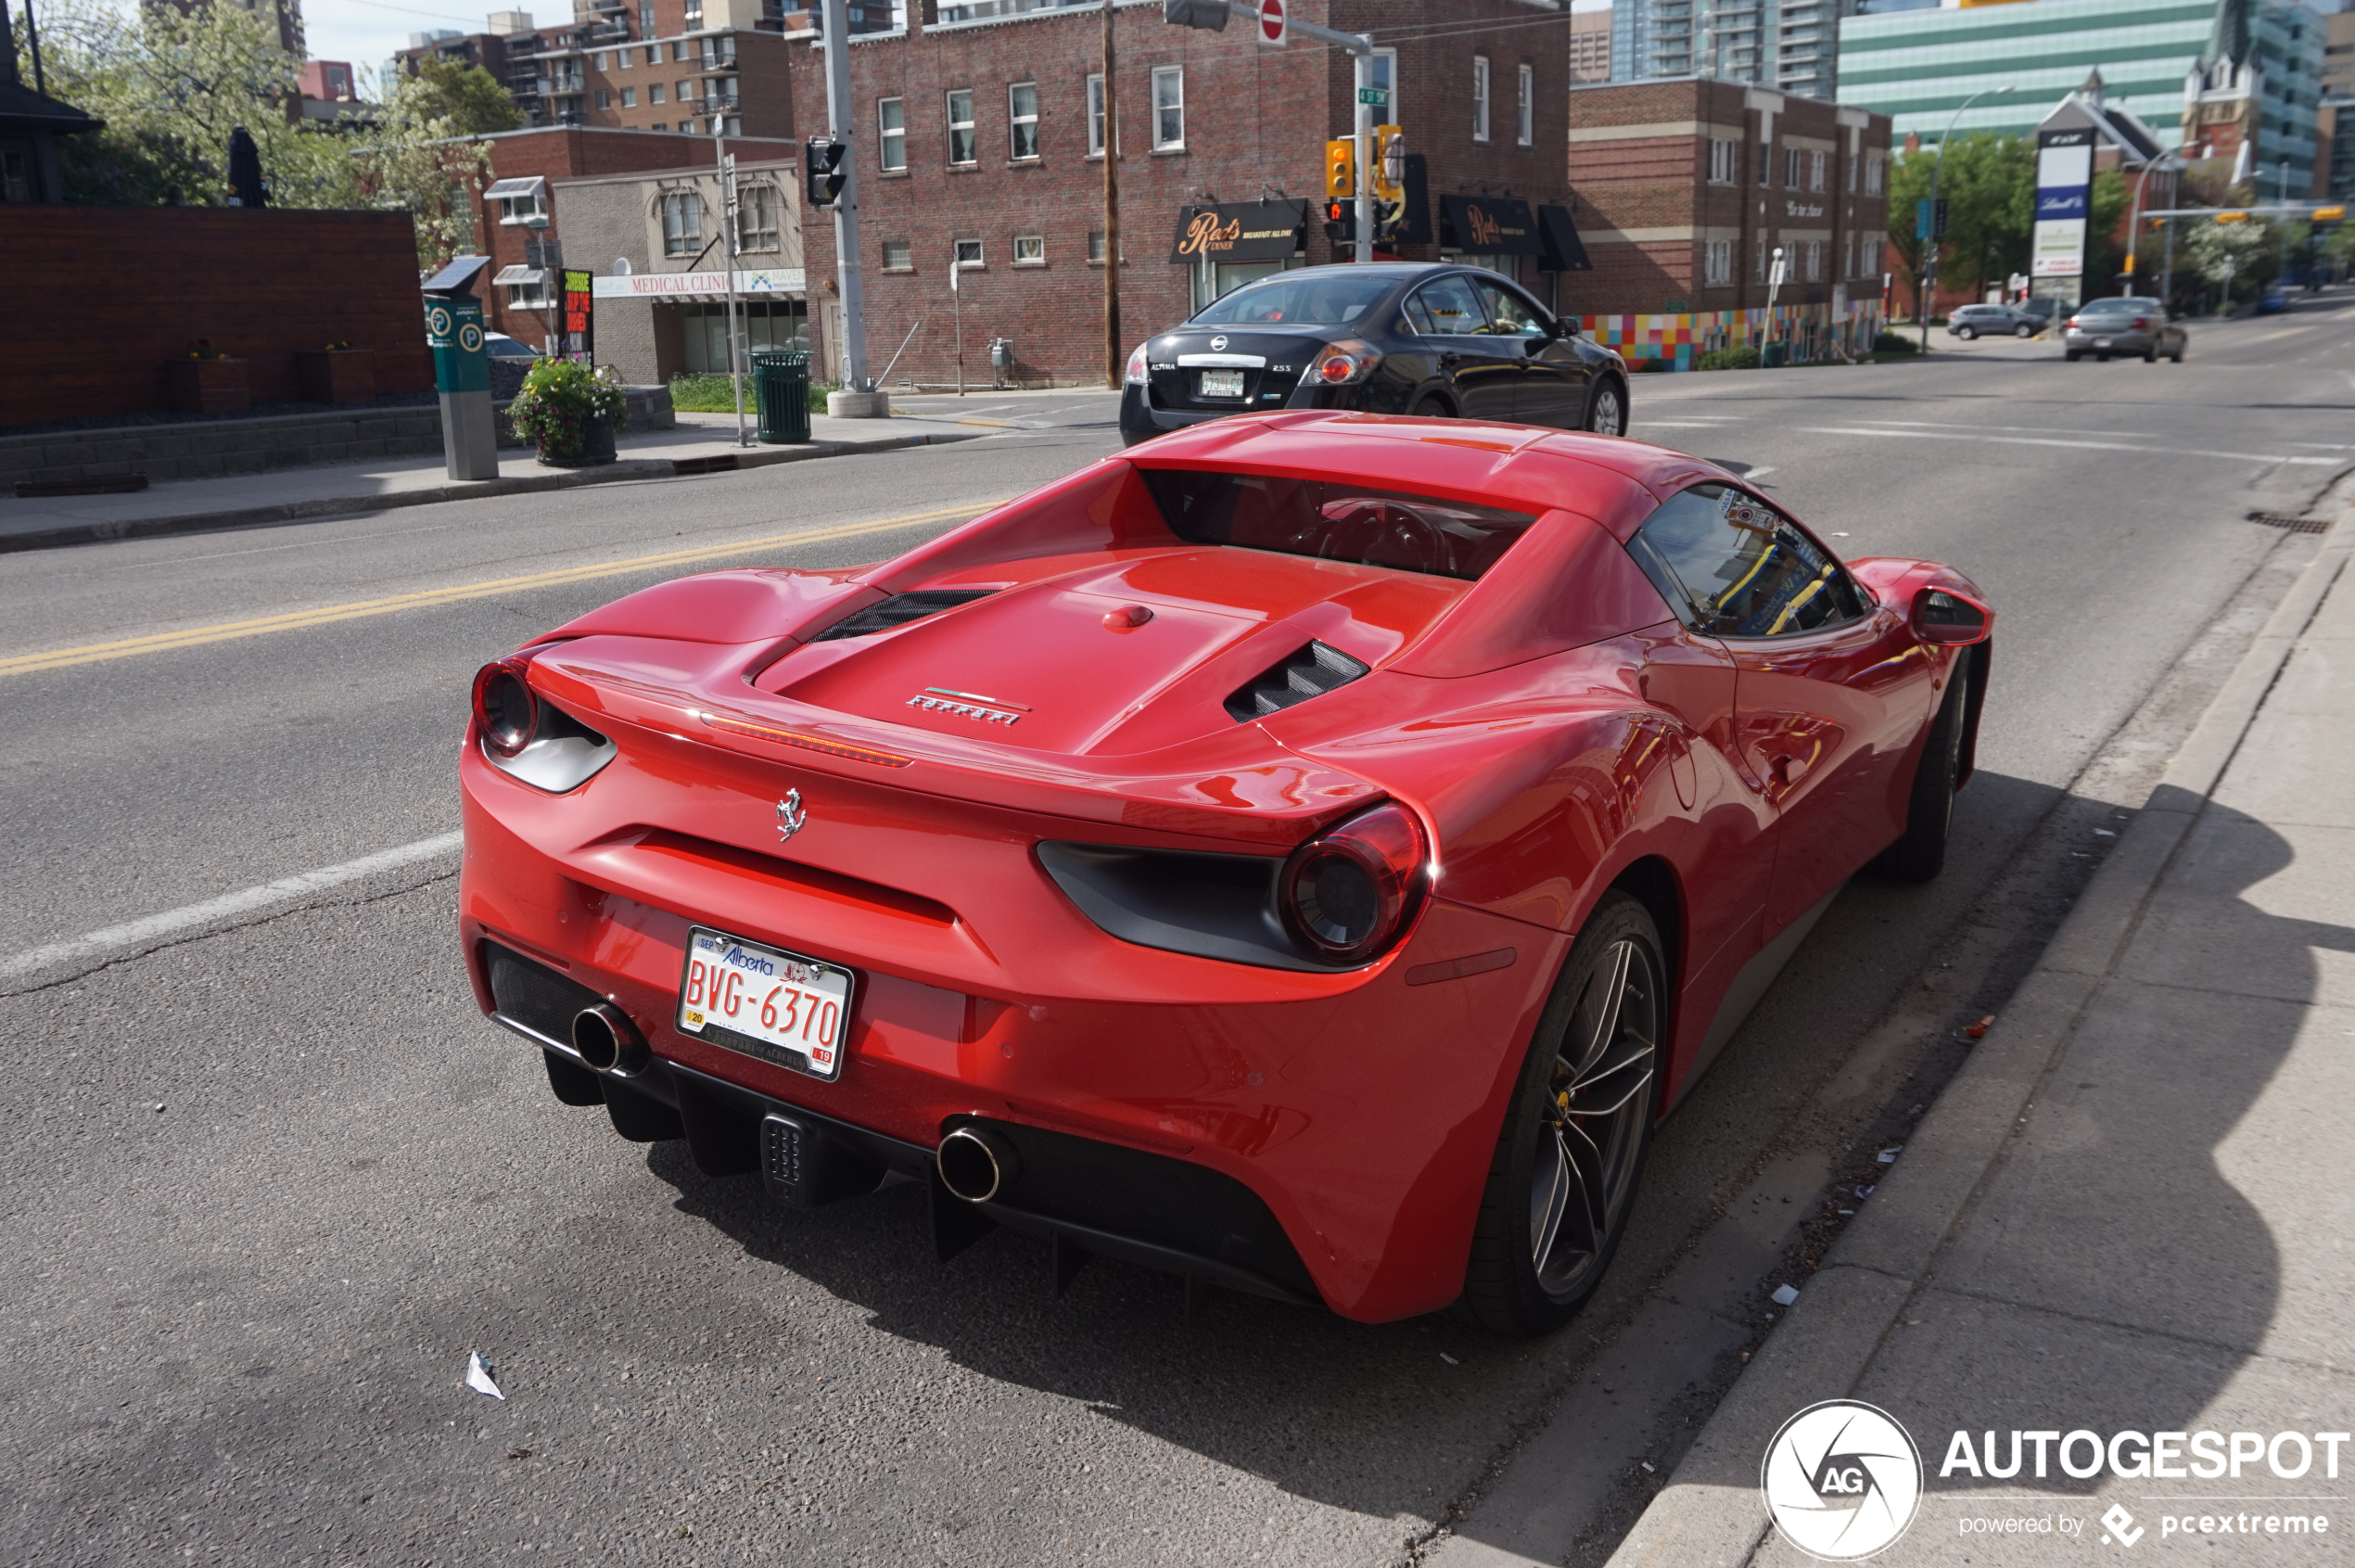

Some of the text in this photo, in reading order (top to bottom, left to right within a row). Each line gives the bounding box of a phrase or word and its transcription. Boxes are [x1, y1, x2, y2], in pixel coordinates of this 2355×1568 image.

[1359, 90, 1385, 103] 4 ST SW
[1178, 212, 1241, 254] Red's
[1242, 231, 1271, 239] BREAKFAST
[1280, 229, 1292, 237] DAY
[1210, 241, 1234, 250] DINER
[772, 270, 805, 281] MAVEN
[631, 275, 689, 294] MEDICAL
[567, 292, 591, 312] SKIP THE
[566, 312, 587, 332] DISHES
[1202, 377, 1242, 390] 473 LGR
[906, 695, 1020, 725] Ferrari
[700, 938, 714, 950] SEP
[722, 945, 774, 976] Alberta
[686, 959, 838, 1047] BVG-6370
[692, 1013, 703, 1024] 20
[766, 1049, 805, 1066] ALBERTA
[819, 1050, 831, 1062] 19
